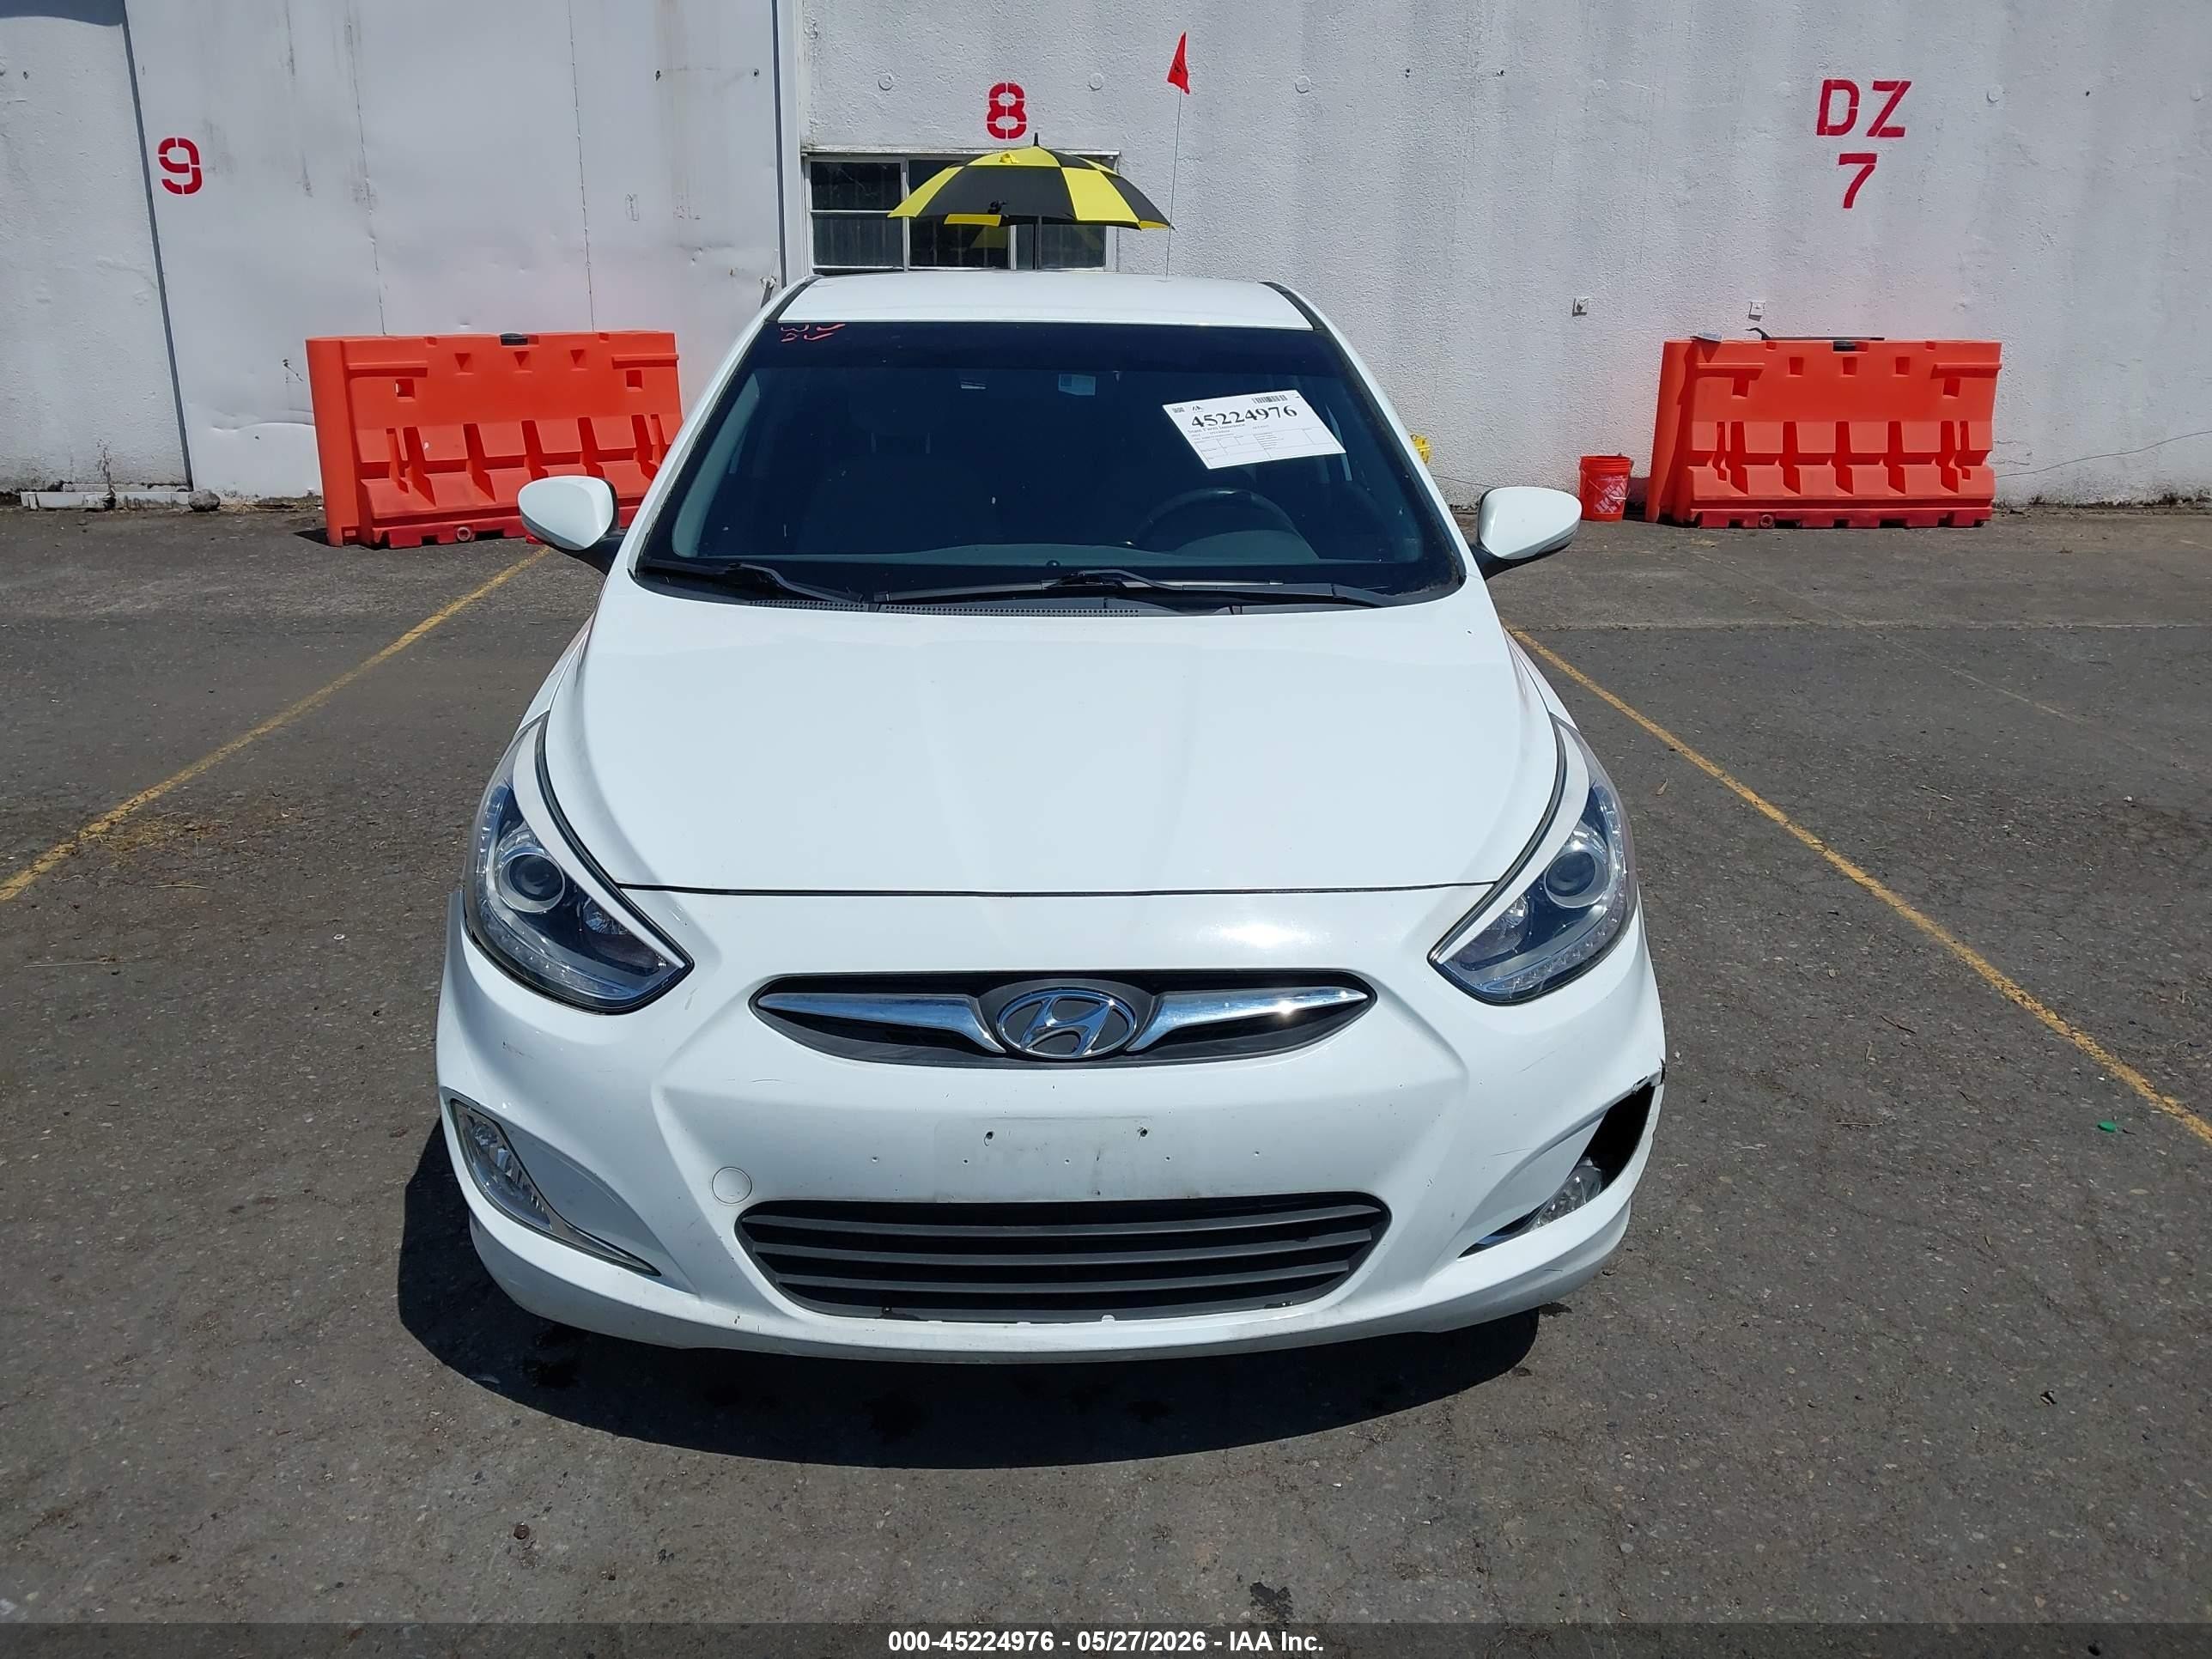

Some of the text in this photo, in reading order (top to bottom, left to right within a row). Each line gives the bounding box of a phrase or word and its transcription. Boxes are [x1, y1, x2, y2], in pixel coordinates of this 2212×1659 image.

[987, 82, 1027, 140] 8
[1816, 78, 1912, 138] DZ
[158, 137, 203, 195] 9
[1838, 153, 1878, 210] 7
[1192, 405, 1297, 428] 45224976
